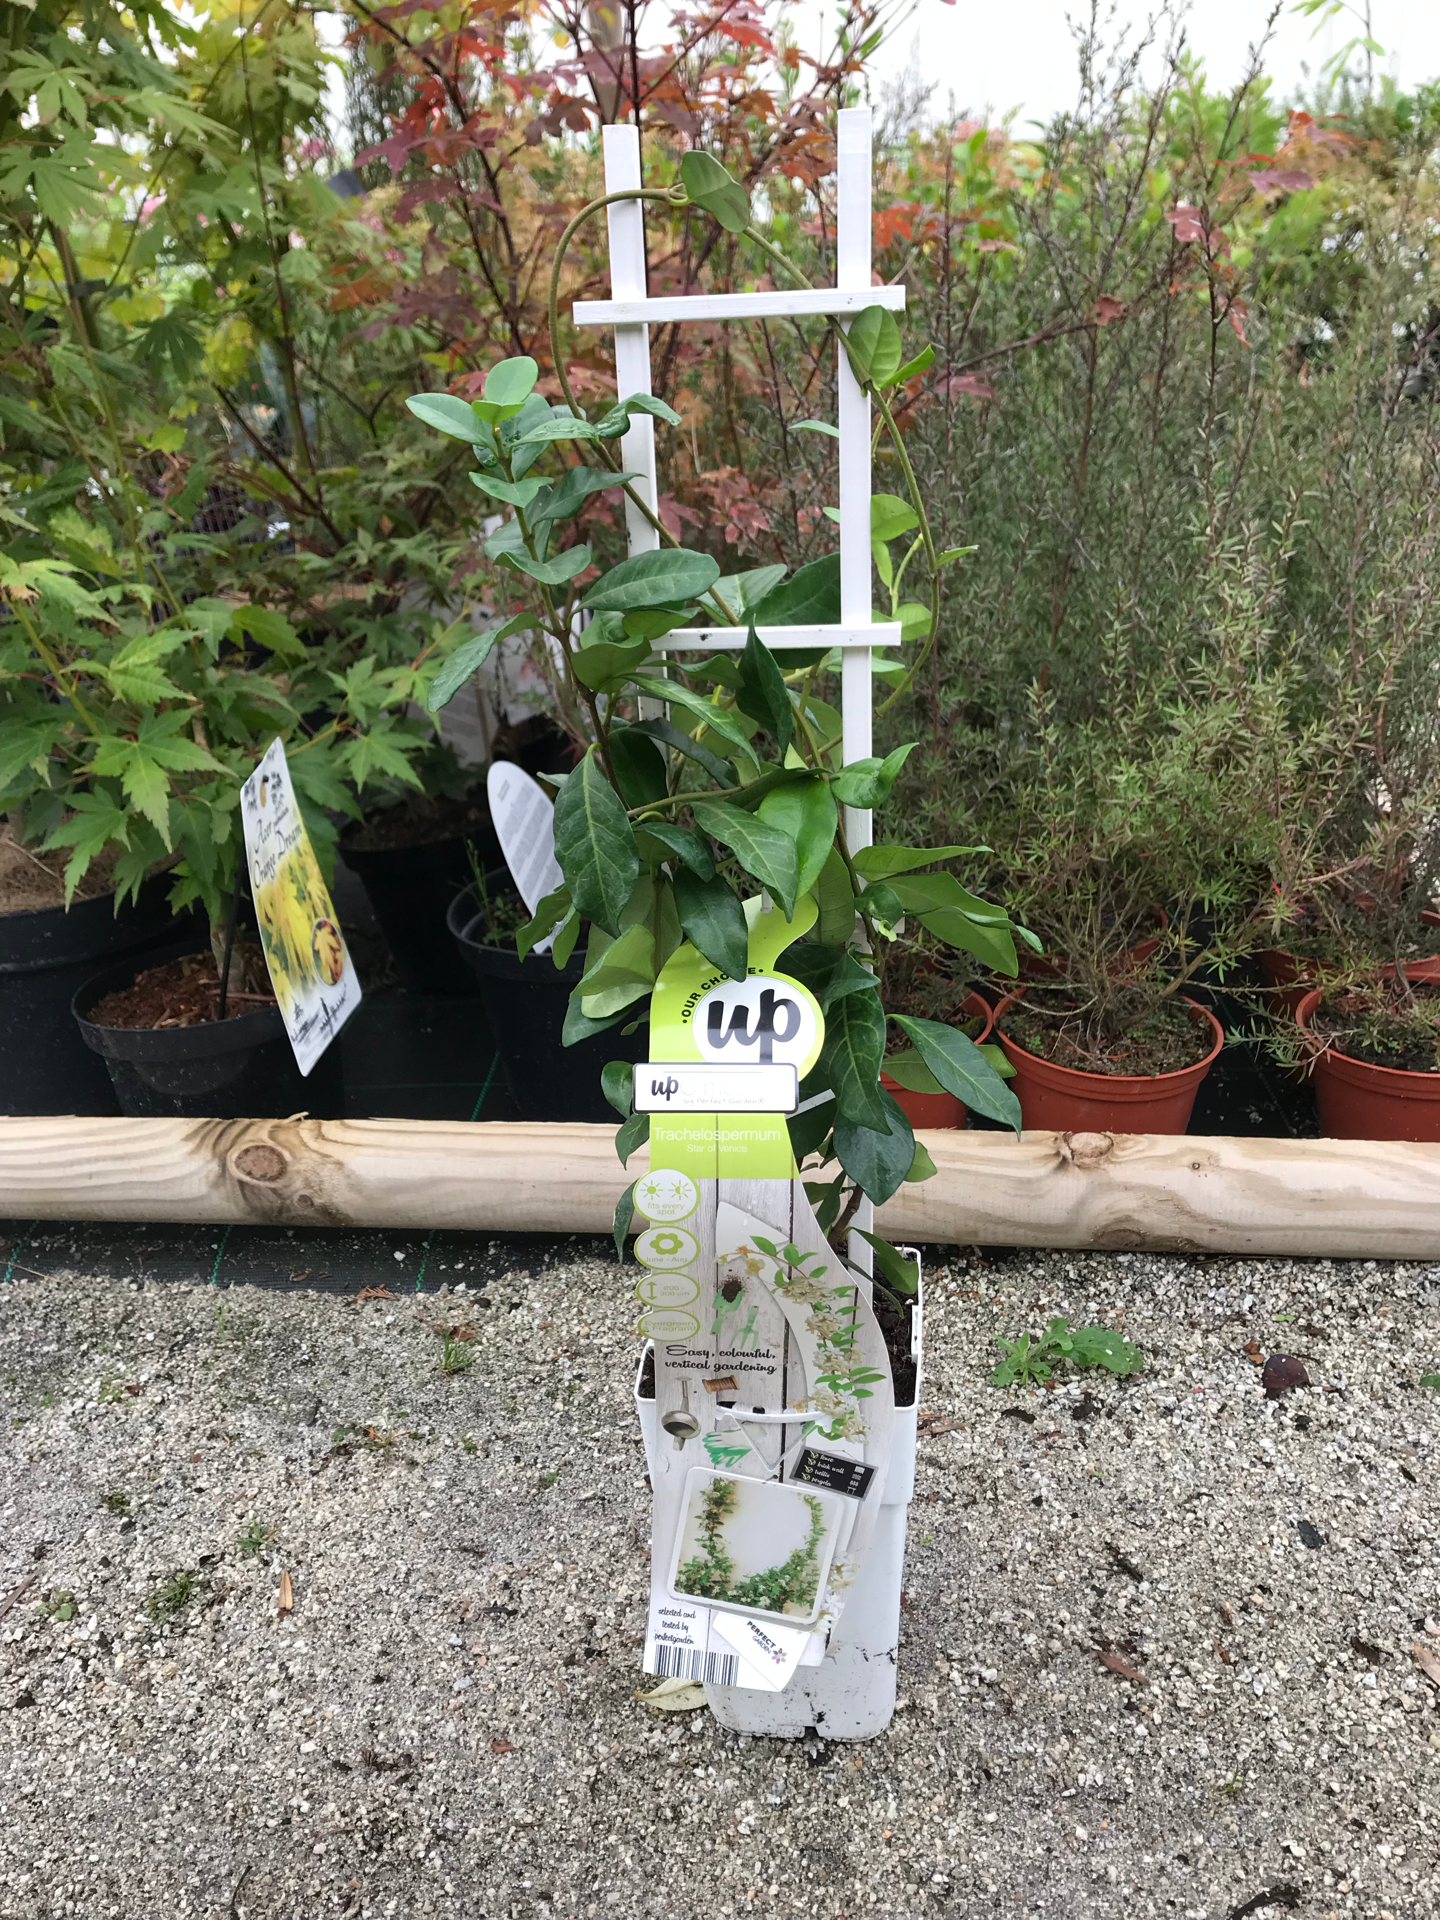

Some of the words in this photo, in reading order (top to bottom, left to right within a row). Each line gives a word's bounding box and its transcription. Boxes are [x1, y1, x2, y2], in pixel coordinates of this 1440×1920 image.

[681, 992, 701, 1018] OUR
[701, 967, 757, 991] CHOE
[707, 988, 802, 1063] up
[650, 1075, 679, 1101] up
[683, 1097, 695, 1107] by
[696, 1097, 726, 1105] Perfect
[652, 1126, 782, 1144] Trachelospermum
[687, 1144, 705, 1154] Star
[707, 1143, 717, 1154] of
[718, 1144, 748, 1154] Venice
[647, 1202, 660, 1210] fits
[661, 1203, 685, 1211] every
[644, 1320, 695, 1328] Evergreen
[665, 1360, 710, 1370] vertical
[713, 1361, 777, 1375] gardening
[658, 1606, 682, 1618] selected
[682, 1610, 697, 1620] and
[662, 1620, 681, 1630] tested
[681, 1622, 689, 1634] by
[746, 1620, 777, 1649] PERFECT
[752, 1634, 772, 1655] GARDEN
